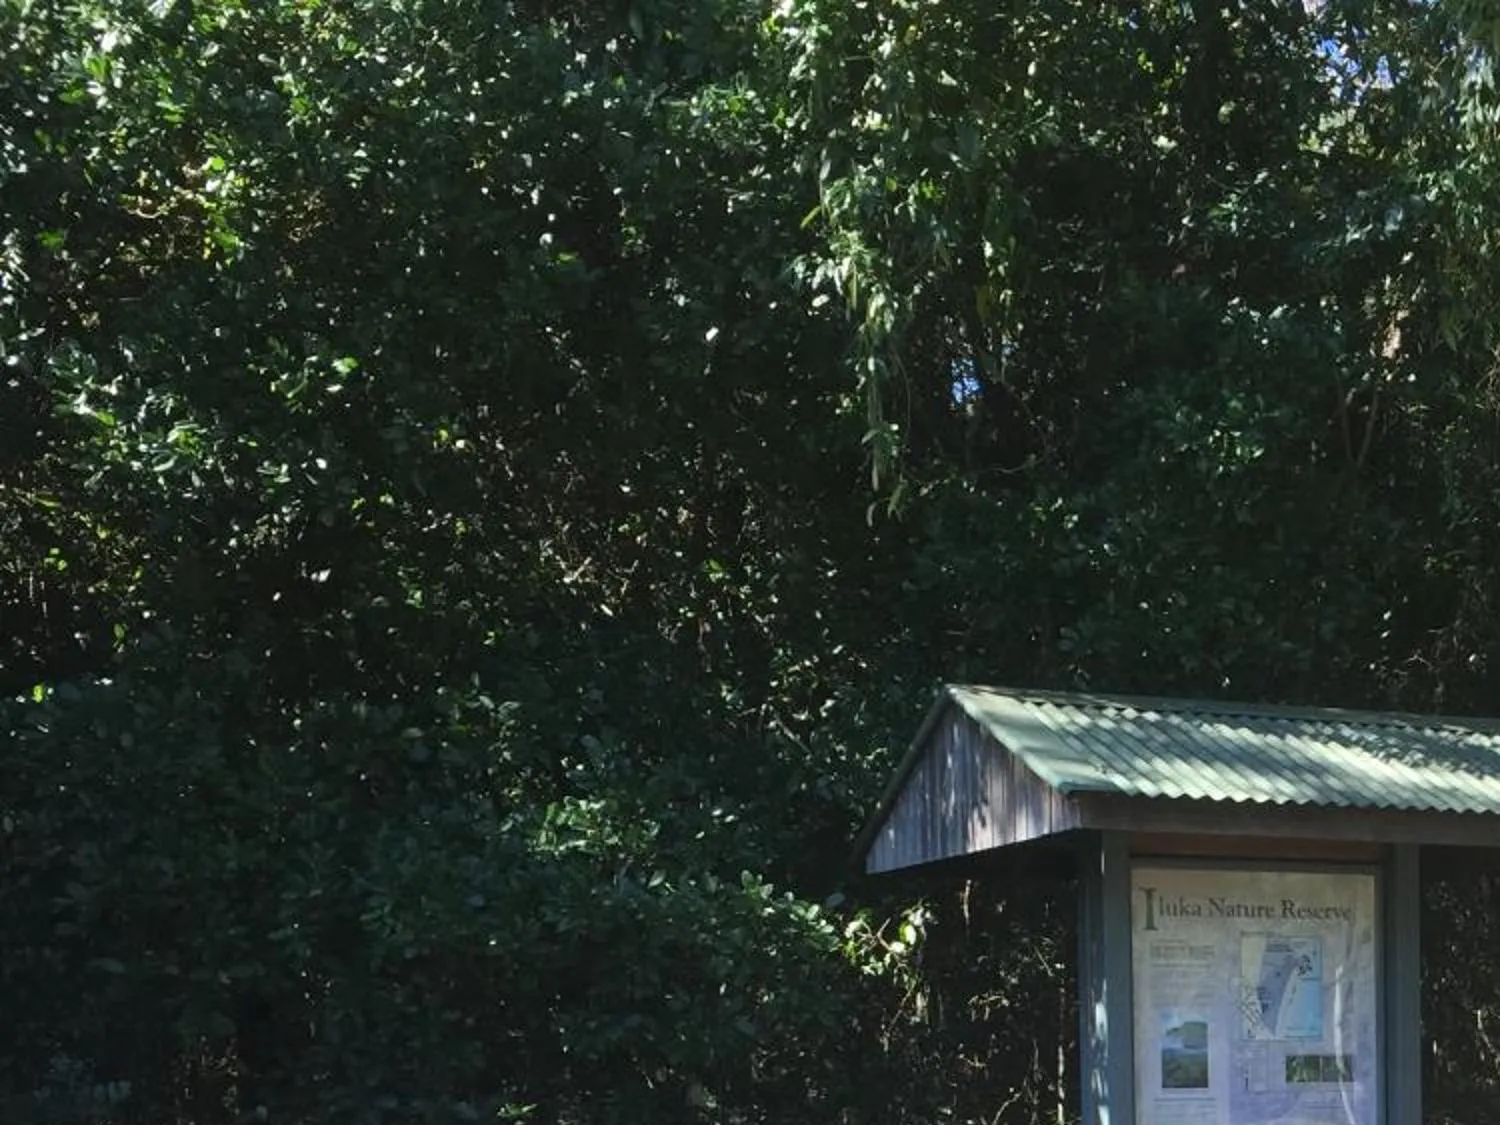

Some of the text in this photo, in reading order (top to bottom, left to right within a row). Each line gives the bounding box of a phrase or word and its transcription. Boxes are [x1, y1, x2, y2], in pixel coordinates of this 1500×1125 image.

[1138, 887, 1352, 930] Iluka Nature Reserve
